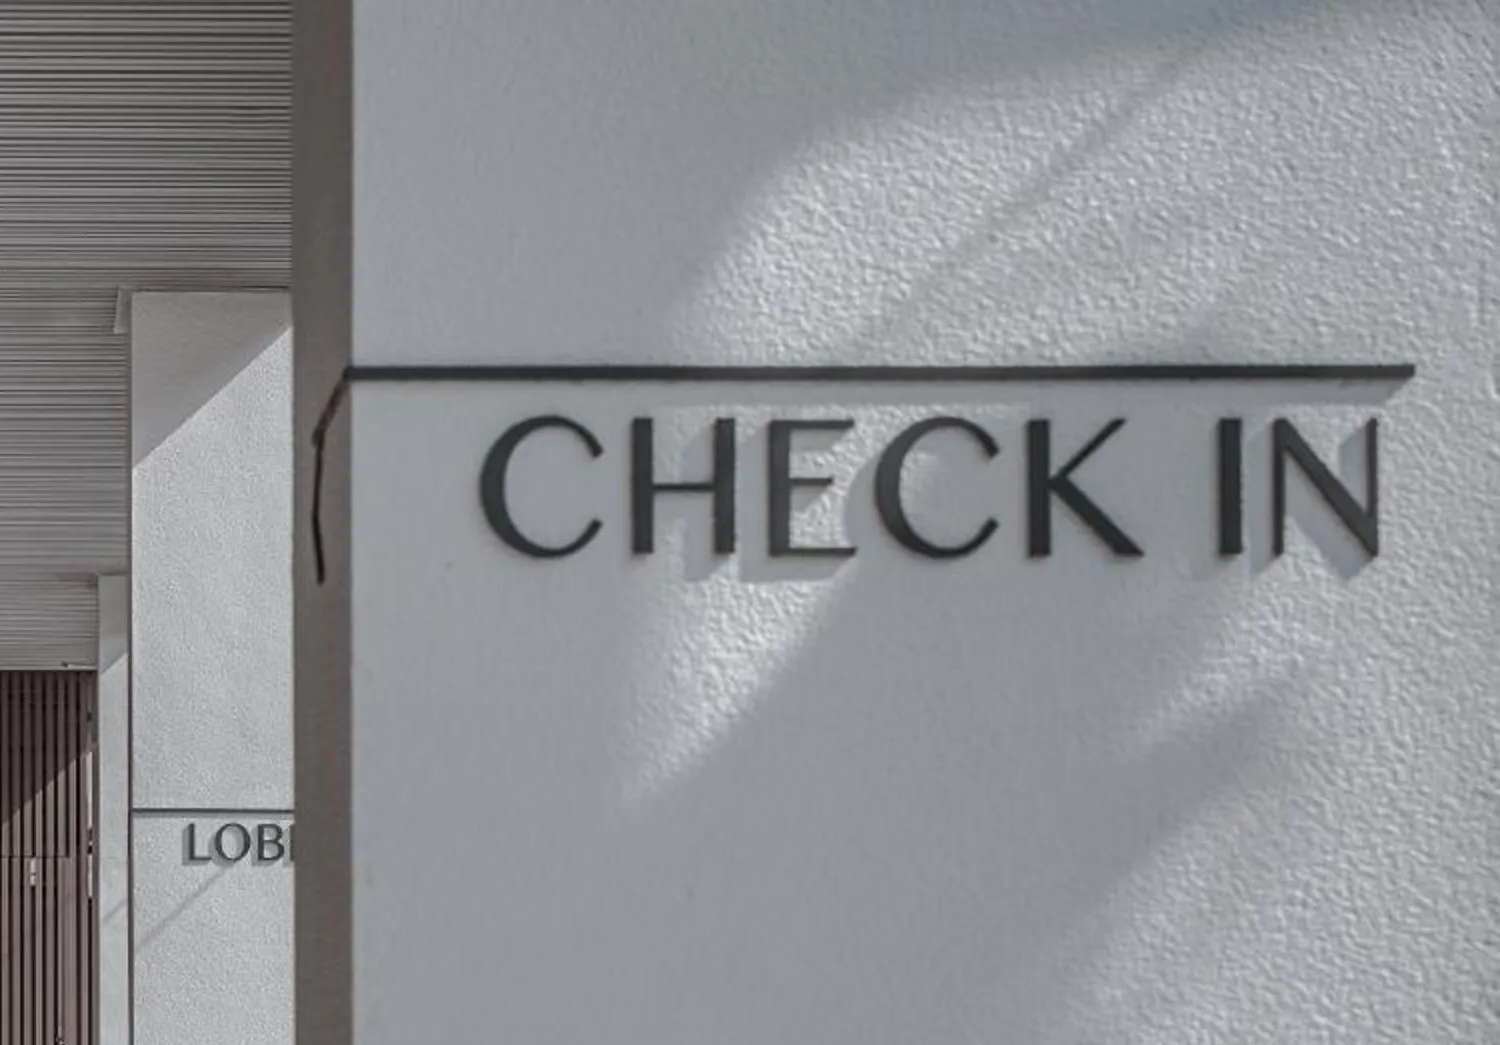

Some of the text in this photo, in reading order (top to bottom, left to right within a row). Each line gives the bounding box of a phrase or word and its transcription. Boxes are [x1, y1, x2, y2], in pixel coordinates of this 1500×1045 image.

[479, 414, 1379, 558] CHECK IN
[187, 822, 295, 862] LOB
